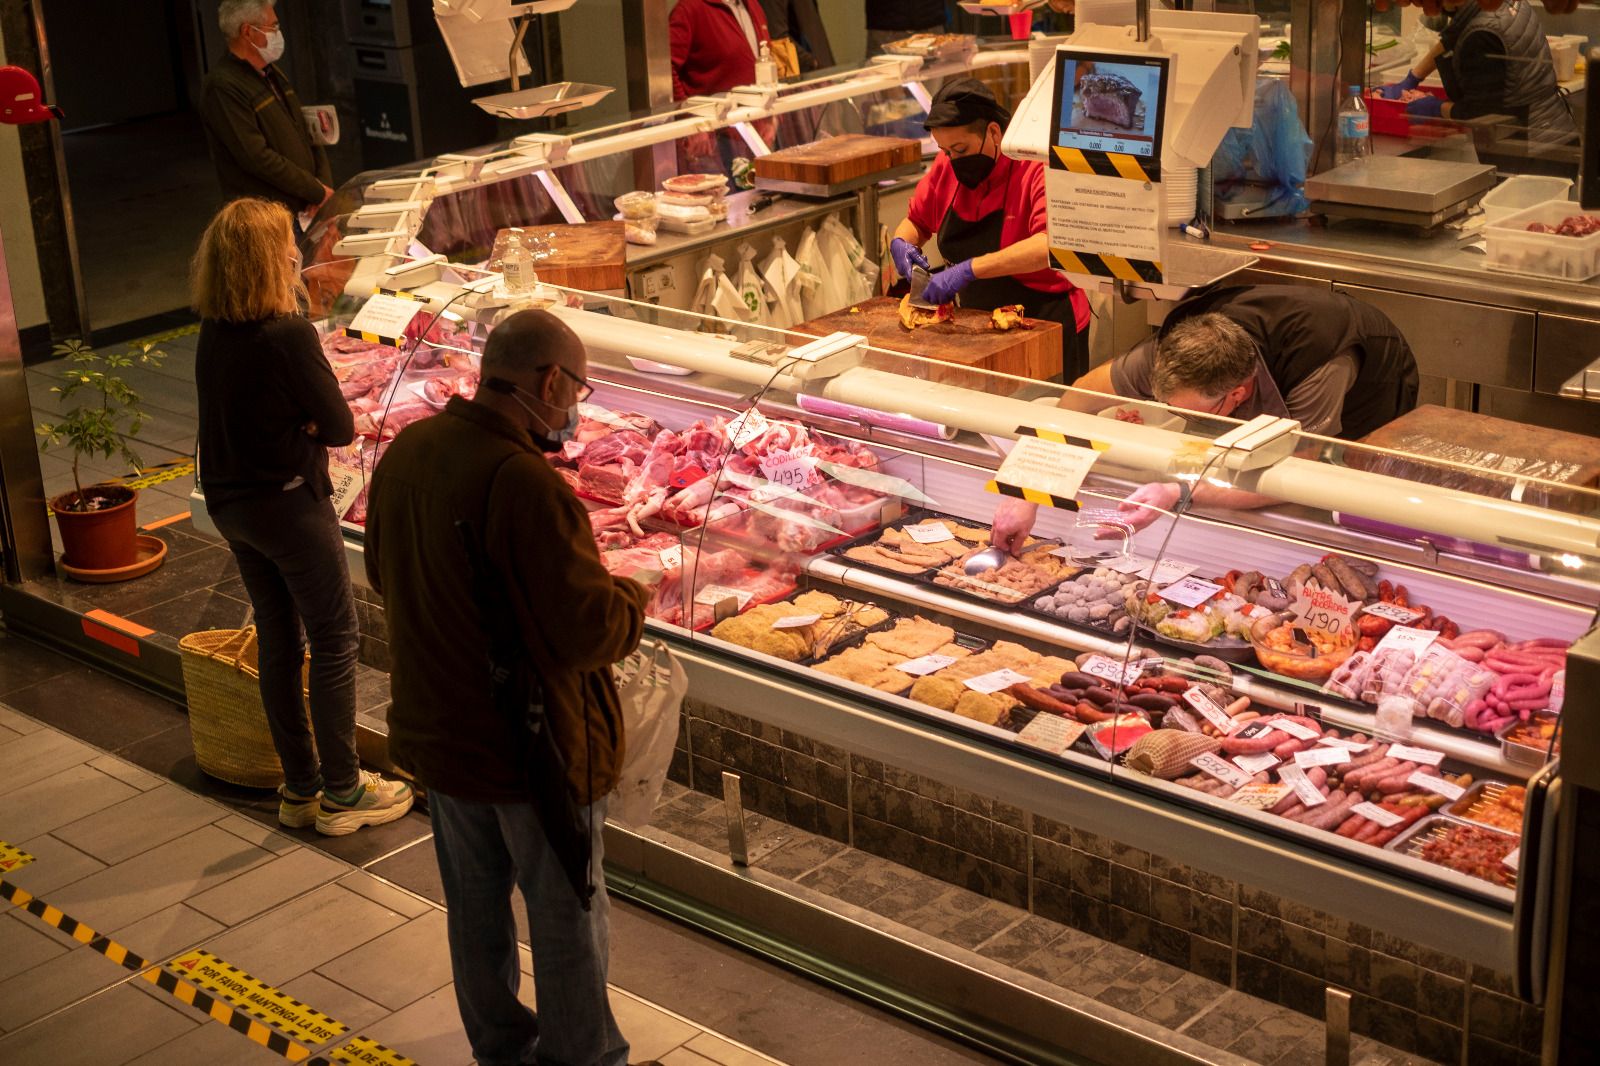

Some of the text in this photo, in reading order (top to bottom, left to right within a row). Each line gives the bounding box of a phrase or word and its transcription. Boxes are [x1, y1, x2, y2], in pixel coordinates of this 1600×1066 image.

[765, 449, 809, 468] CODILLOS
[1302, 587, 1333, 601] ALITAS
[1311, 599, 1349, 615] ADOBADAS
[198, 965, 216, 980] POR
[216, 975, 247, 998] FAVOR,
[248, 991, 298, 1024] MANTENGA
[297, 1018, 312, 1031] LA
[342, 1043, 364, 1057] CIA
[360, 1052, 380, 1065] DE
